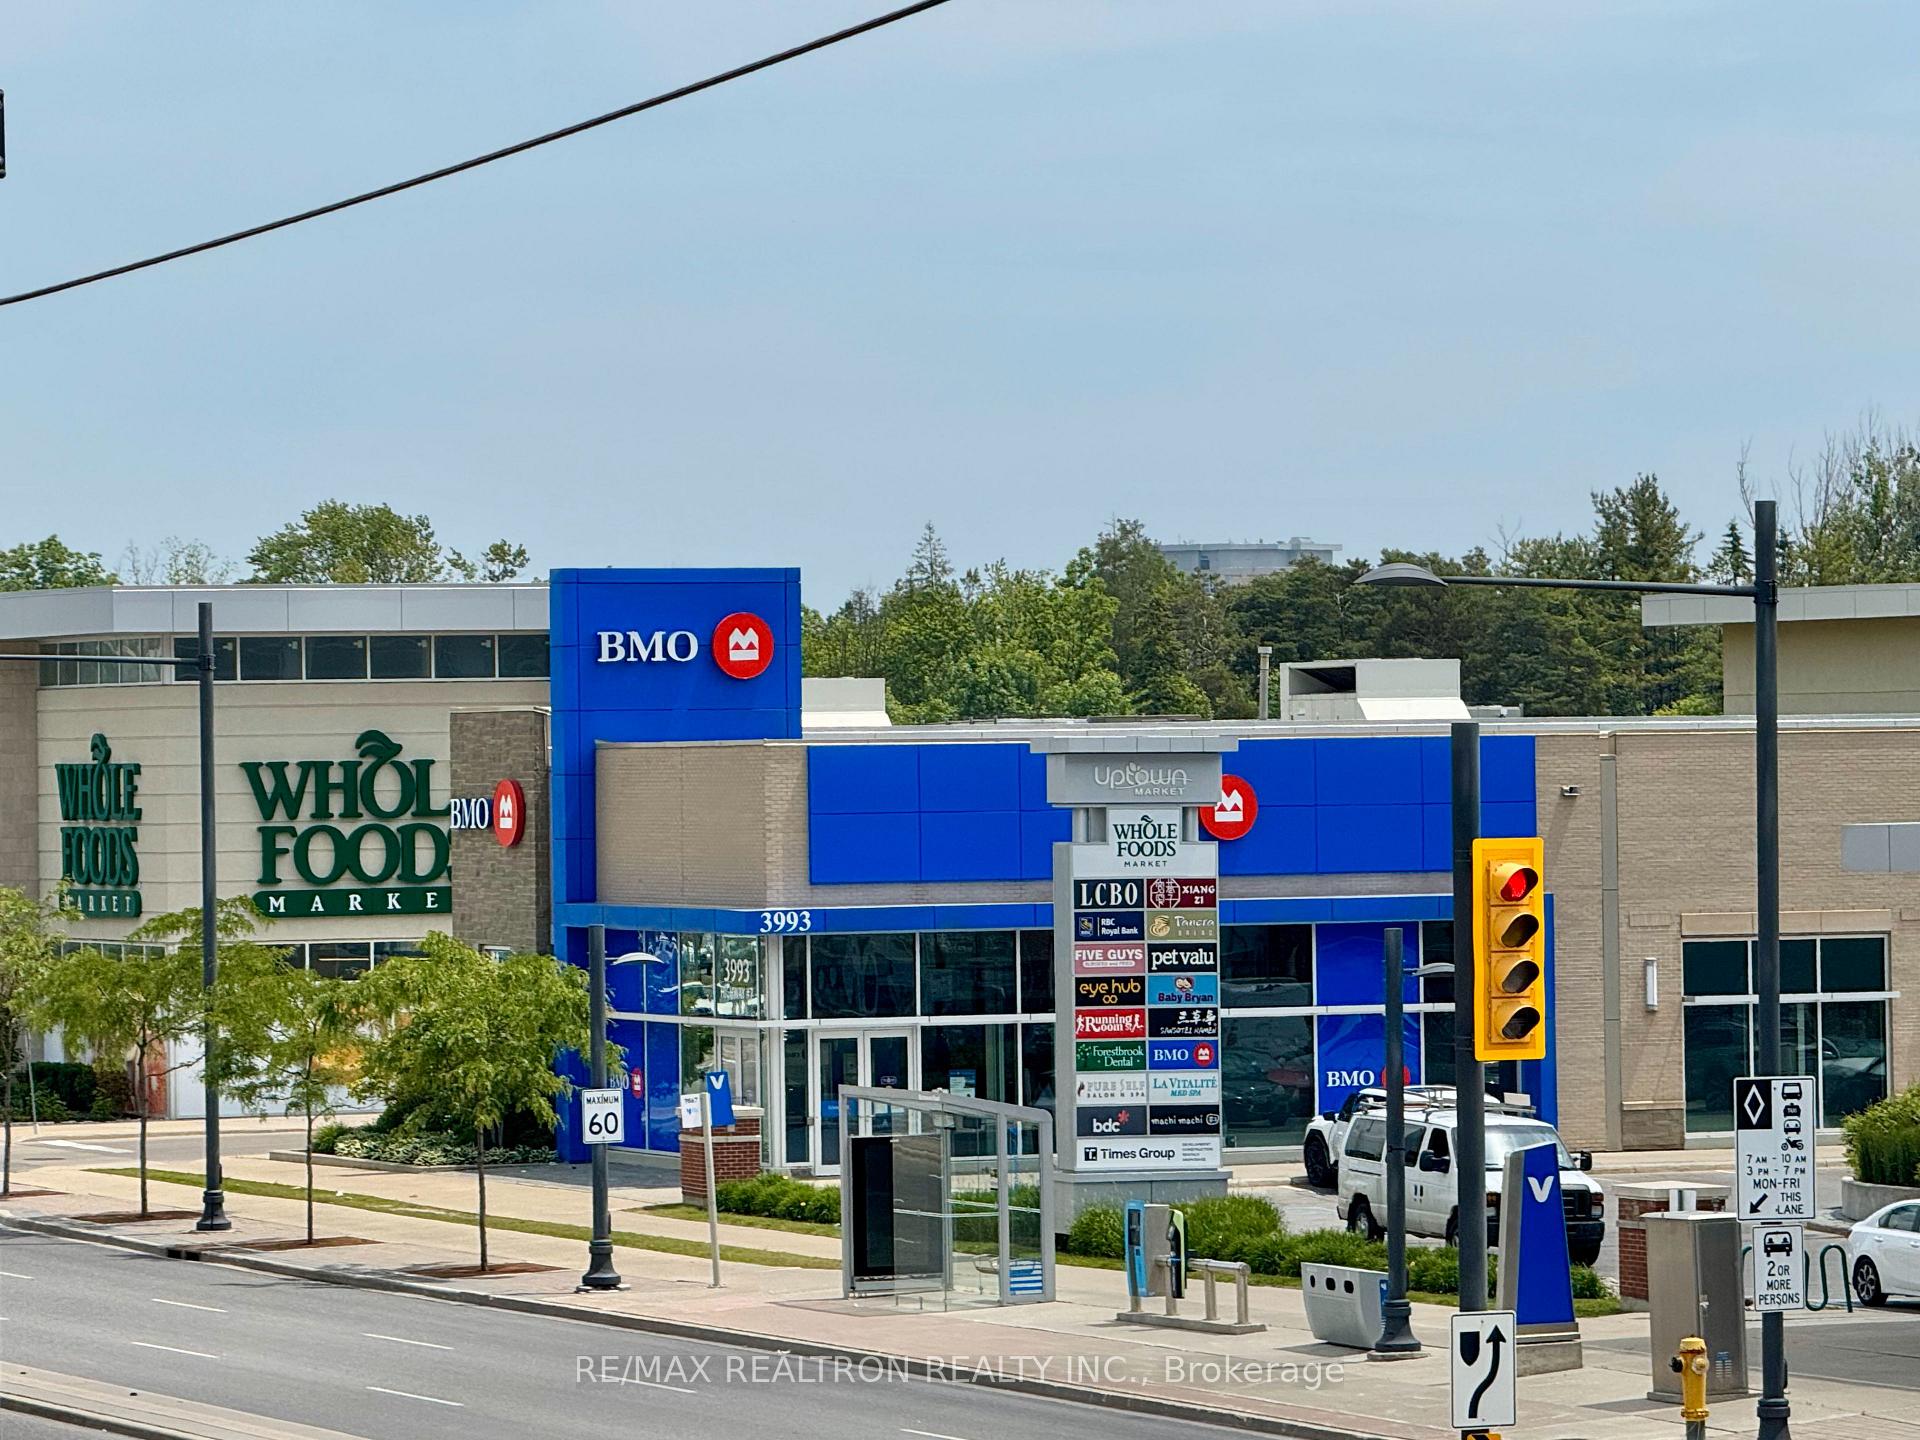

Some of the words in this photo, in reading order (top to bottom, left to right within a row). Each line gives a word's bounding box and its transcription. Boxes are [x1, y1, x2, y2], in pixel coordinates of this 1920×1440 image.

[597, 631, 699, 662] BMO
[55, 763, 142, 821] WHOLE
[239, 759, 451, 821] WHOL
[1134, 788, 1185, 796] MARKET
[450, 798, 489, 830] BMO
[1113, 823, 1178, 840] WHOLE
[256, 823, 452, 885] FOOD
[1116, 841, 1177, 857] FOODS
[60, 826, 139, 887] FOODS
[1081, 882, 1138, 906] LCBO
[1182, 885, 1216, 894] XIANG
[268, 892, 439, 913] MARKE
[1194, 896, 1204, 905] ZI
[760, 911, 812, 933] 3993
[1101, 918, 1116, 926] RBC
[1101, 926, 1121, 937] Royal
[1121, 926, 1139, 935] Bank
[1075, 949, 1104, 961] FIVE
[1107, 949, 1144, 960] GUYS
[1151, 949, 1179, 970] pet
[1179, 948, 1215, 965] valu
[724, 958, 750, 983] 3993
[1079, 983, 1109, 998] eye
[1112, 978, 1141, 993] hub
[1158, 993, 1182, 1003] Baby
[1184, 993, 1214, 1003] Bryan
[1085, 1014, 1133, 1032] Running
[1092, 1045, 1144, 1057] Forestbrook
[1154, 1049, 1189, 1061] BMO
[1104, 1057, 1133, 1067] Dental
[1326, 1070, 1375, 1087] BMO
[1087, 1081, 1117, 1091] PURE
[586, 1095, 619, 1104] MAXIMUM
[588, 1111, 619, 1135] 60
[1092, 1118, 1120, 1132] bdc
[1150, 1115, 1176, 1125] machi
[1177, 1114, 1203, 1125] machi
[1100, 1148, 1137, 1159] Times
[1139, 1147, 1175, 1160] Group
[1746, 1154, 1753, 1164] 7
[1781, 1154, 1791, 1164] 10
[1795, 1155, 1807, 1163] AM
[1746, 1166, 1753, 1176] 3
[1784, 1165, 1790, 1175] 7
[1794, 1167, 1806, 1175] PM
[1753, 1178, 1800, 1190] MON-FRI
[1780, 1192, 1801, 1202] THIS
[1778, 1204, 1804, 1215] LANE
[1767, 1261, 1776, 1277] 2
[1777, 1265, 1790, 1276] OR
[1766, 1279, 1791, 1290] MORE
[1758, 1293, 1801, 1306] PERSONS
